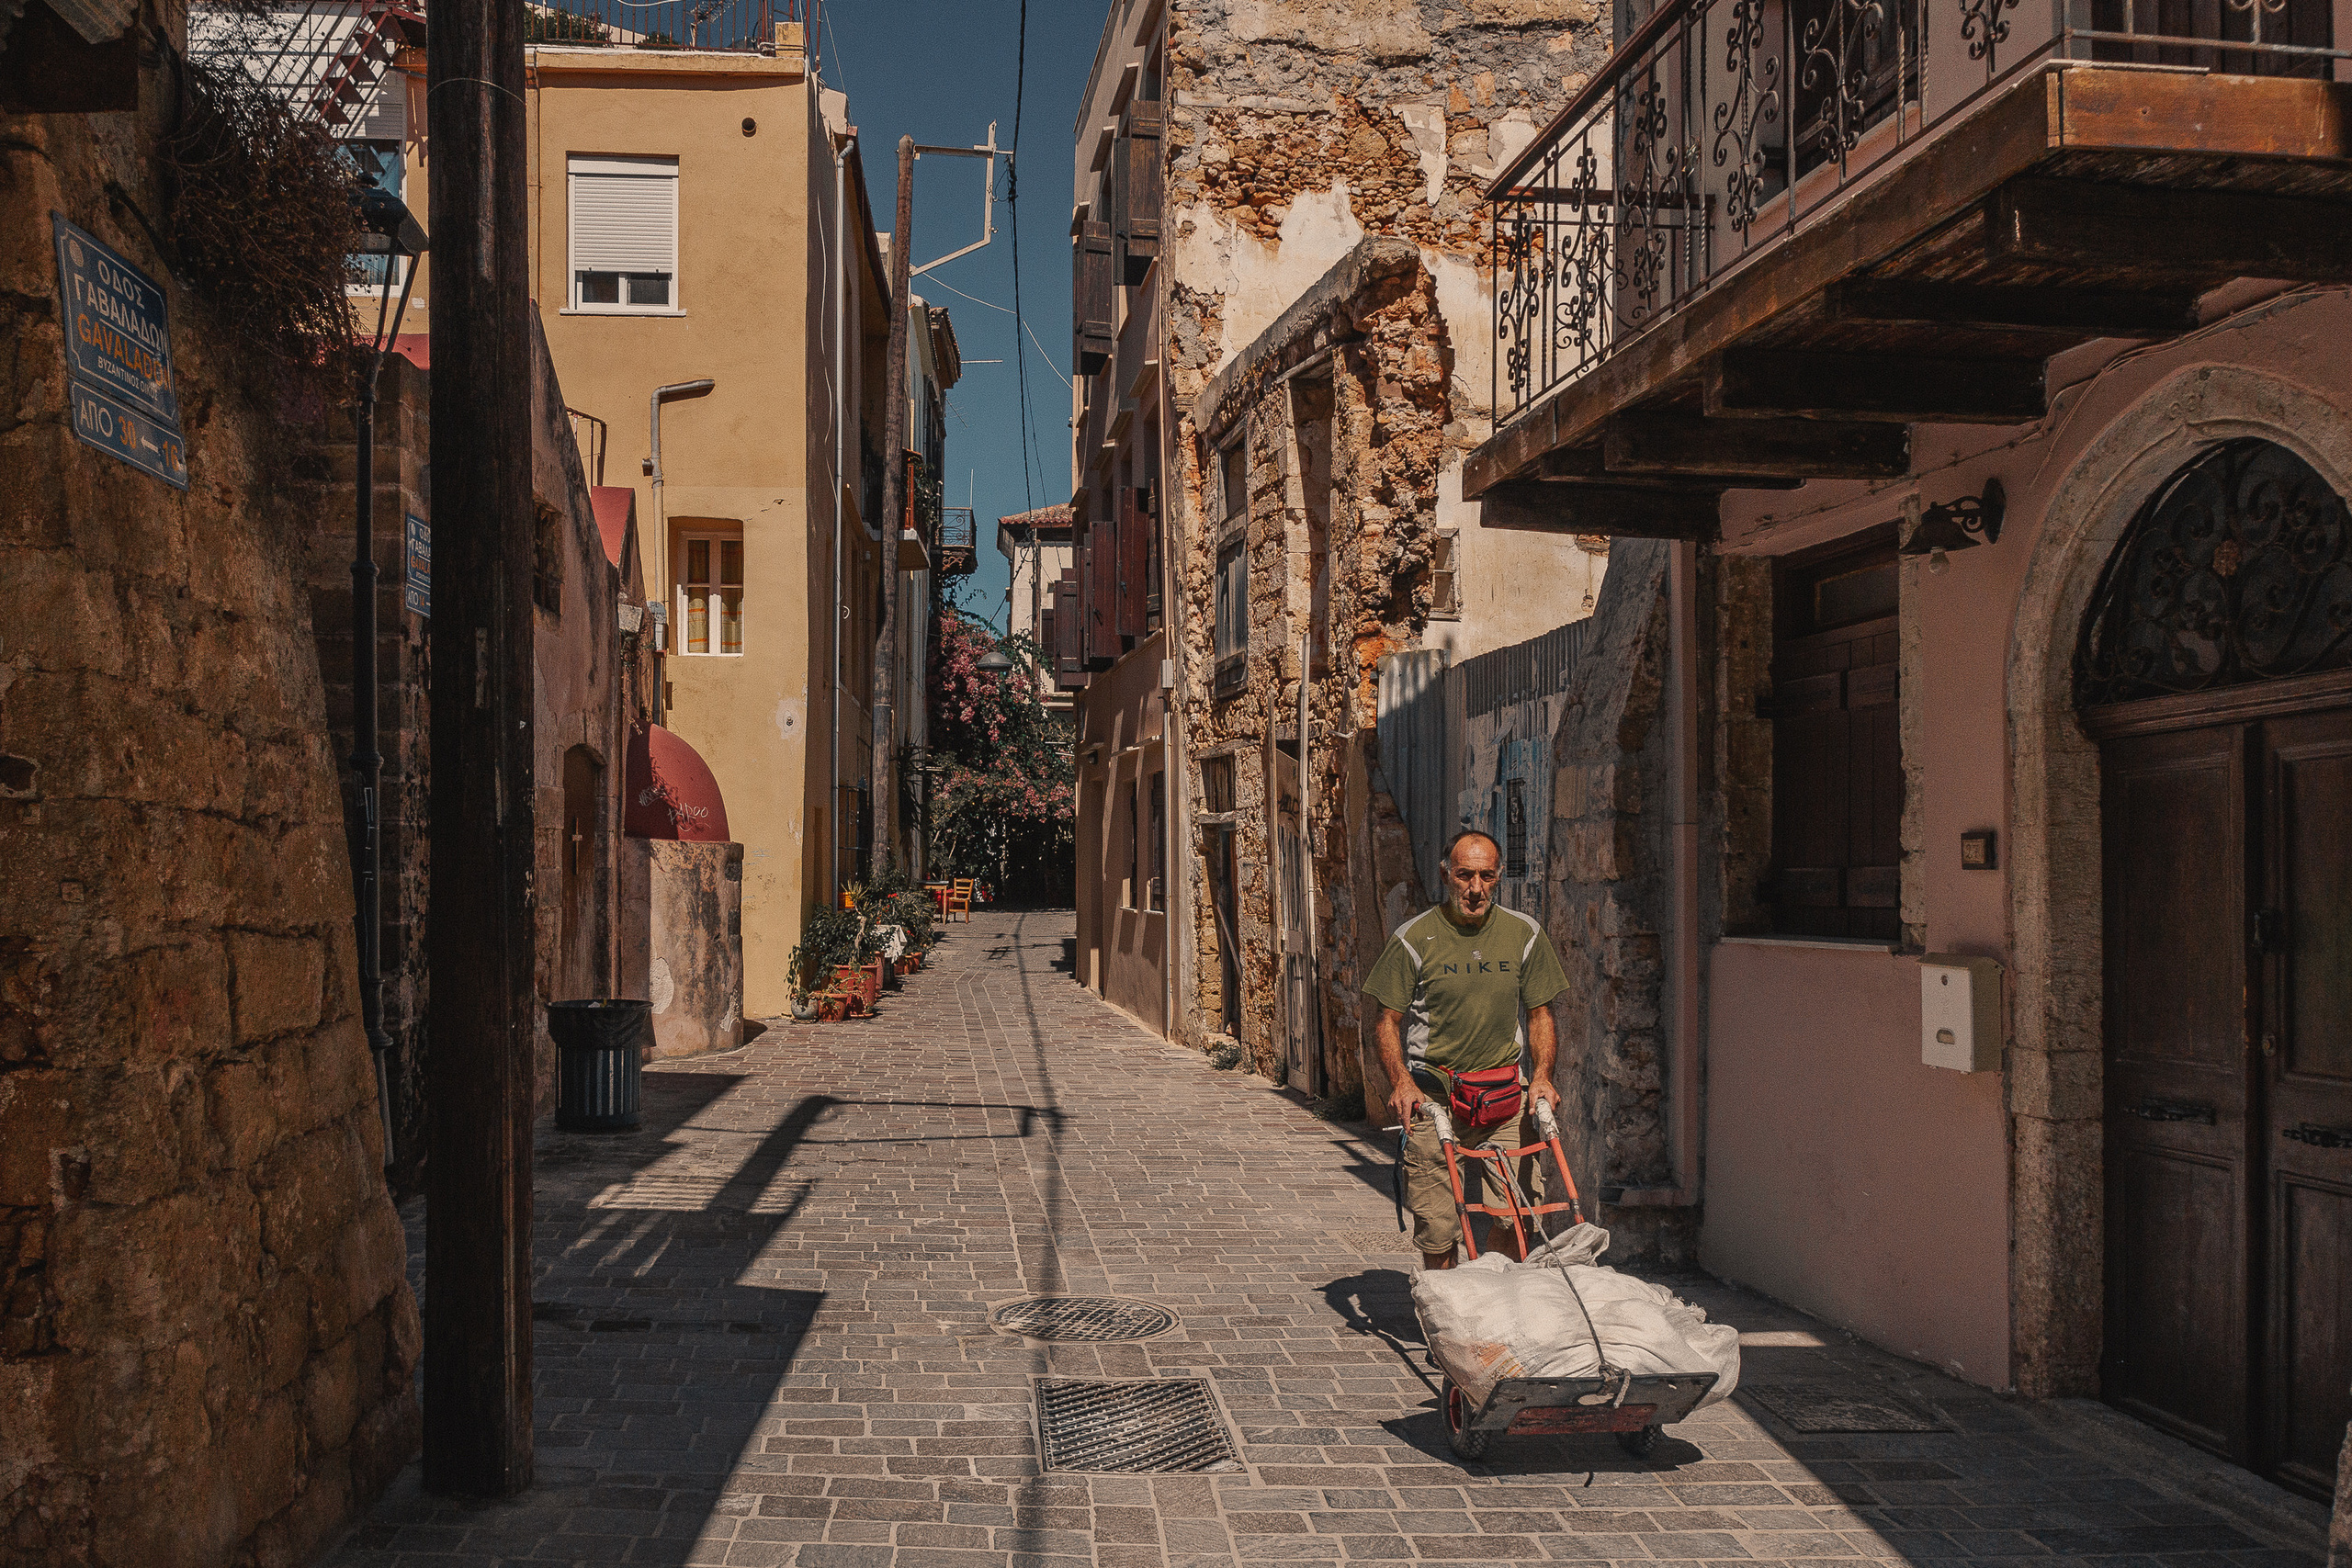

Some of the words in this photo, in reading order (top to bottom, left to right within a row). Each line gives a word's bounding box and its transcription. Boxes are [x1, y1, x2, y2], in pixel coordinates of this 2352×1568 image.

[74, 274, 167, 355] ΓΑΒΑΛΑΔΩΝ
[97, 260, 144, 310] ΟΔΟΣ
[77, 313, 172, 393] GAVALADON
[97, 355, 140, 389] ΒΥΖΑΝΤΙΝΟΣ
[80, 398, 113, 437] ΑΠΟ
[118, 416, 137, 449] 30
[163, 441, 179, 471] 16
[1444, 961, 1510, 975] NIKE
